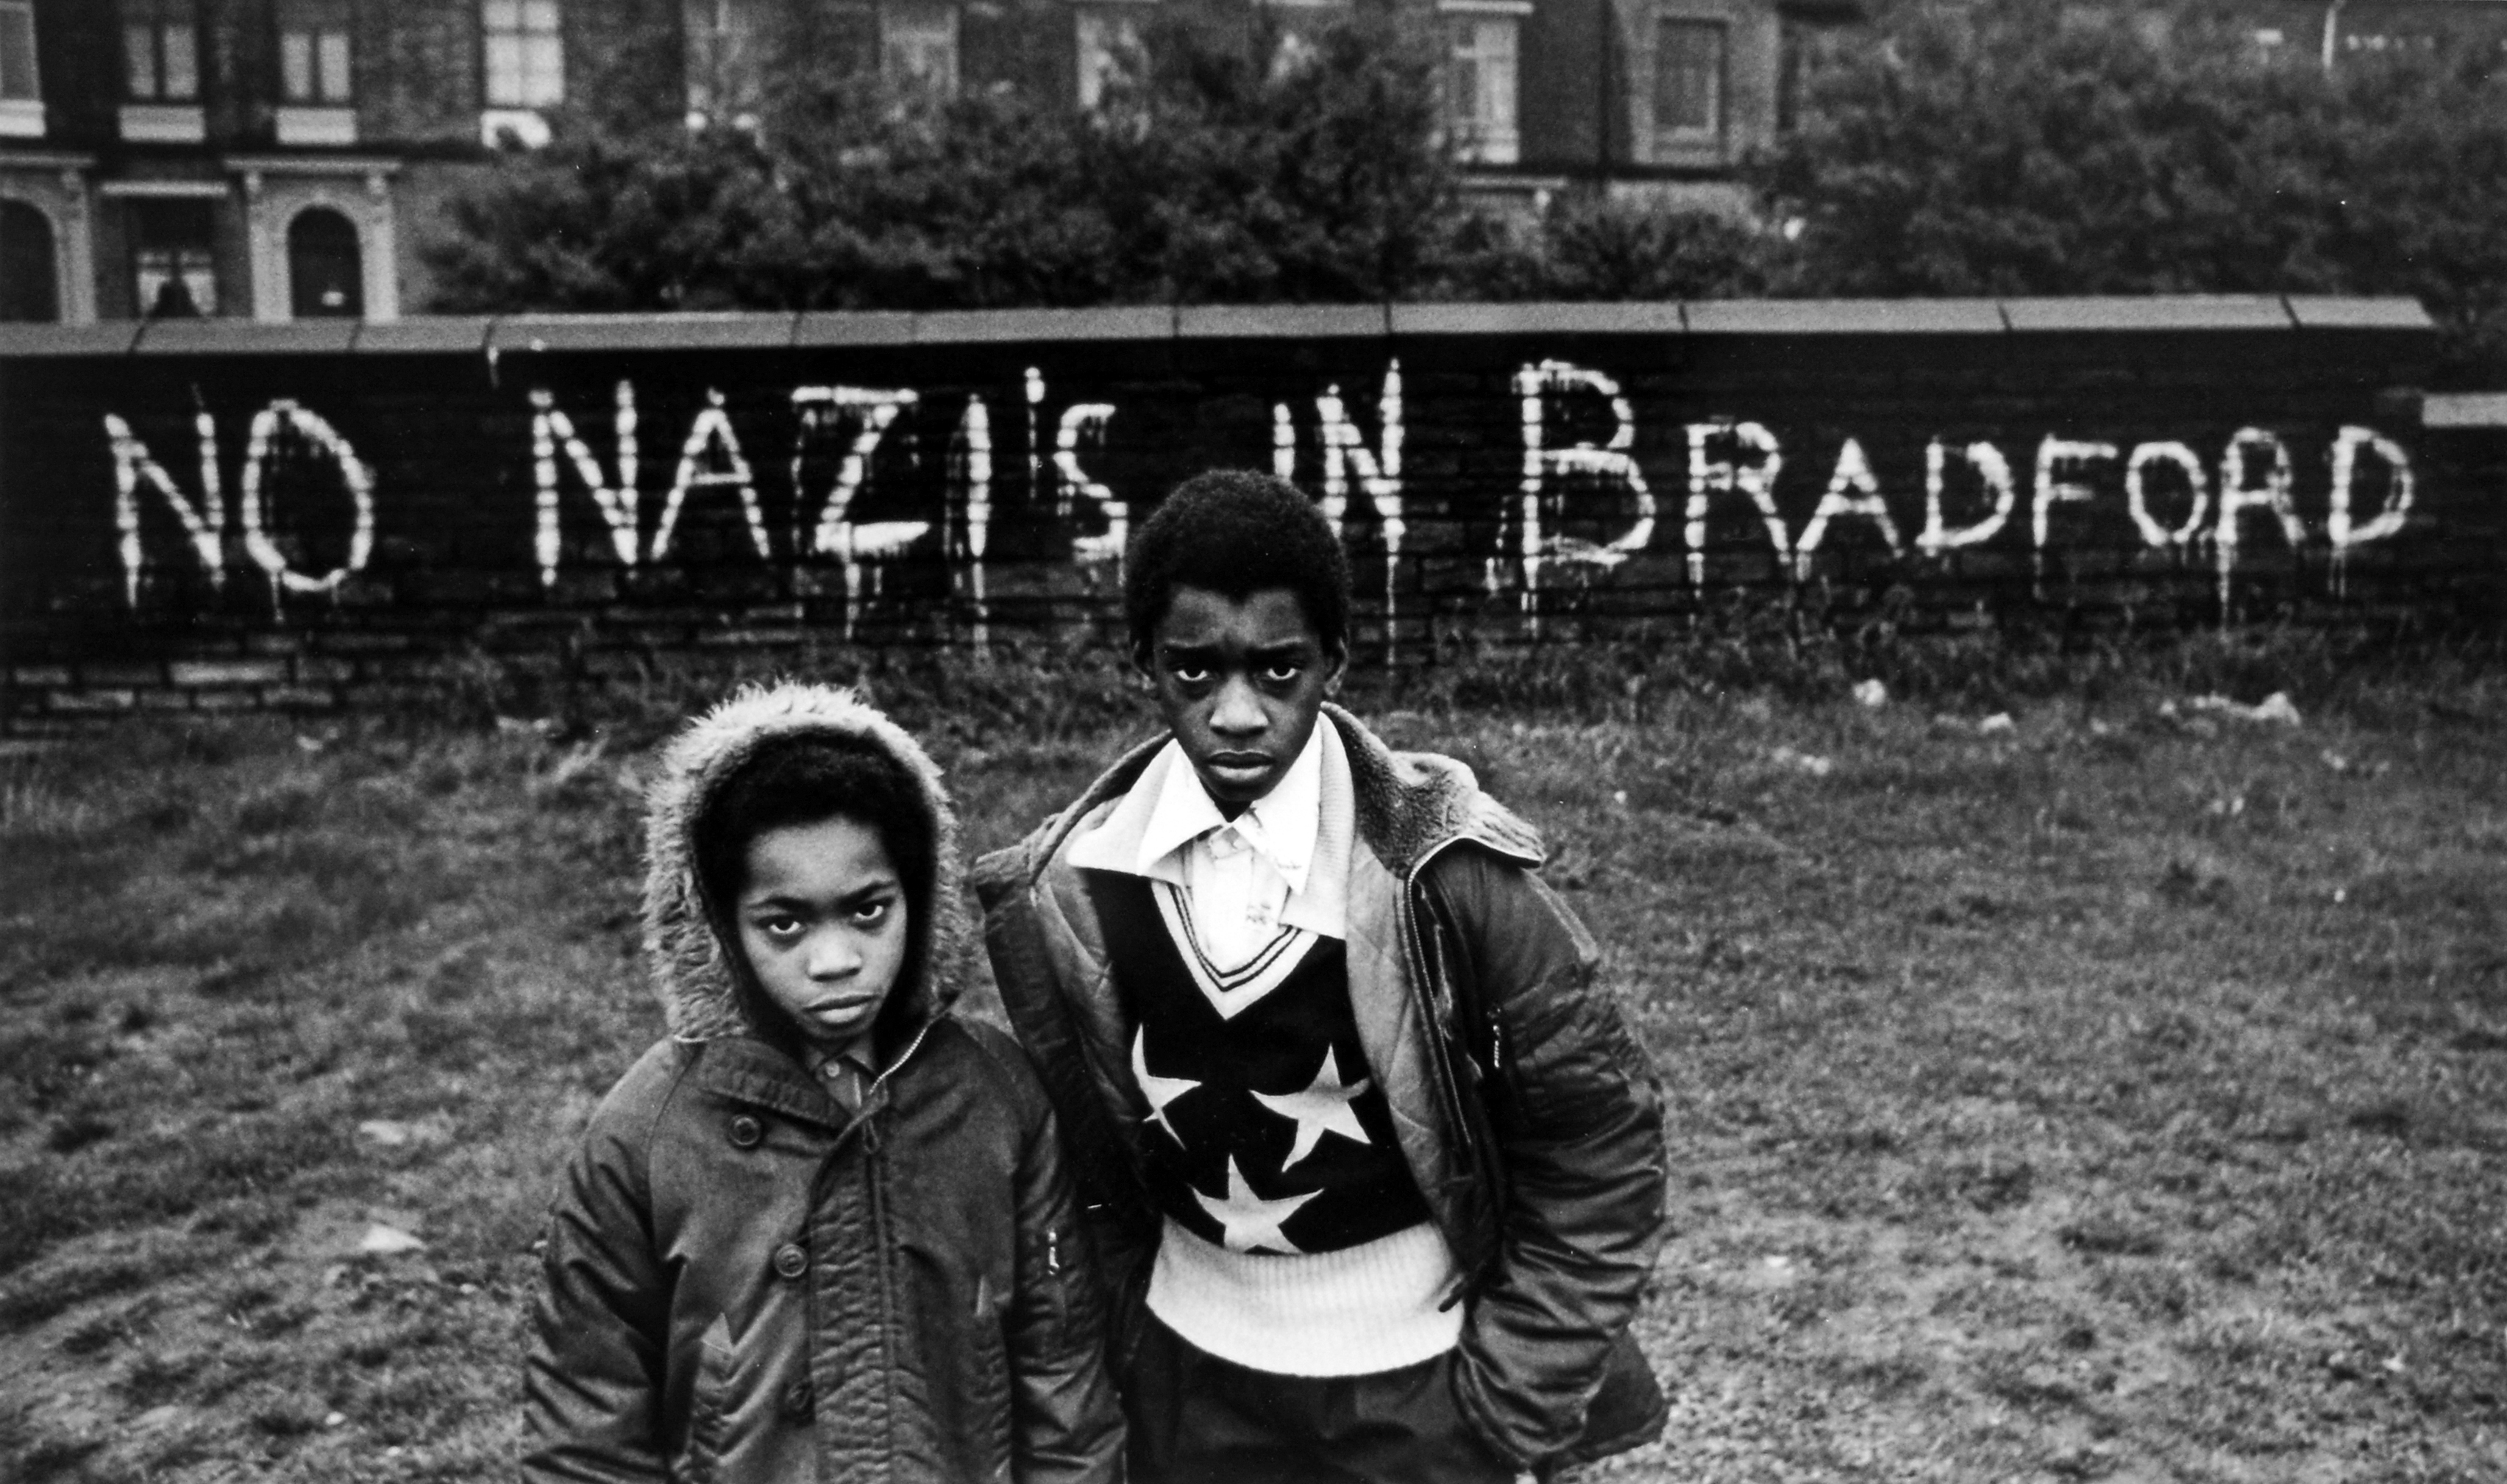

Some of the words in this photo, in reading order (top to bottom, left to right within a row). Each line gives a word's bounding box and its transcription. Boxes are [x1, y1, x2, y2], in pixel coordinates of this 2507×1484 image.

[104, 399, 374, 597] NO
[530, 366, 1129, 586] NAZI'S
[1273, 357, 1404, 557] IN
